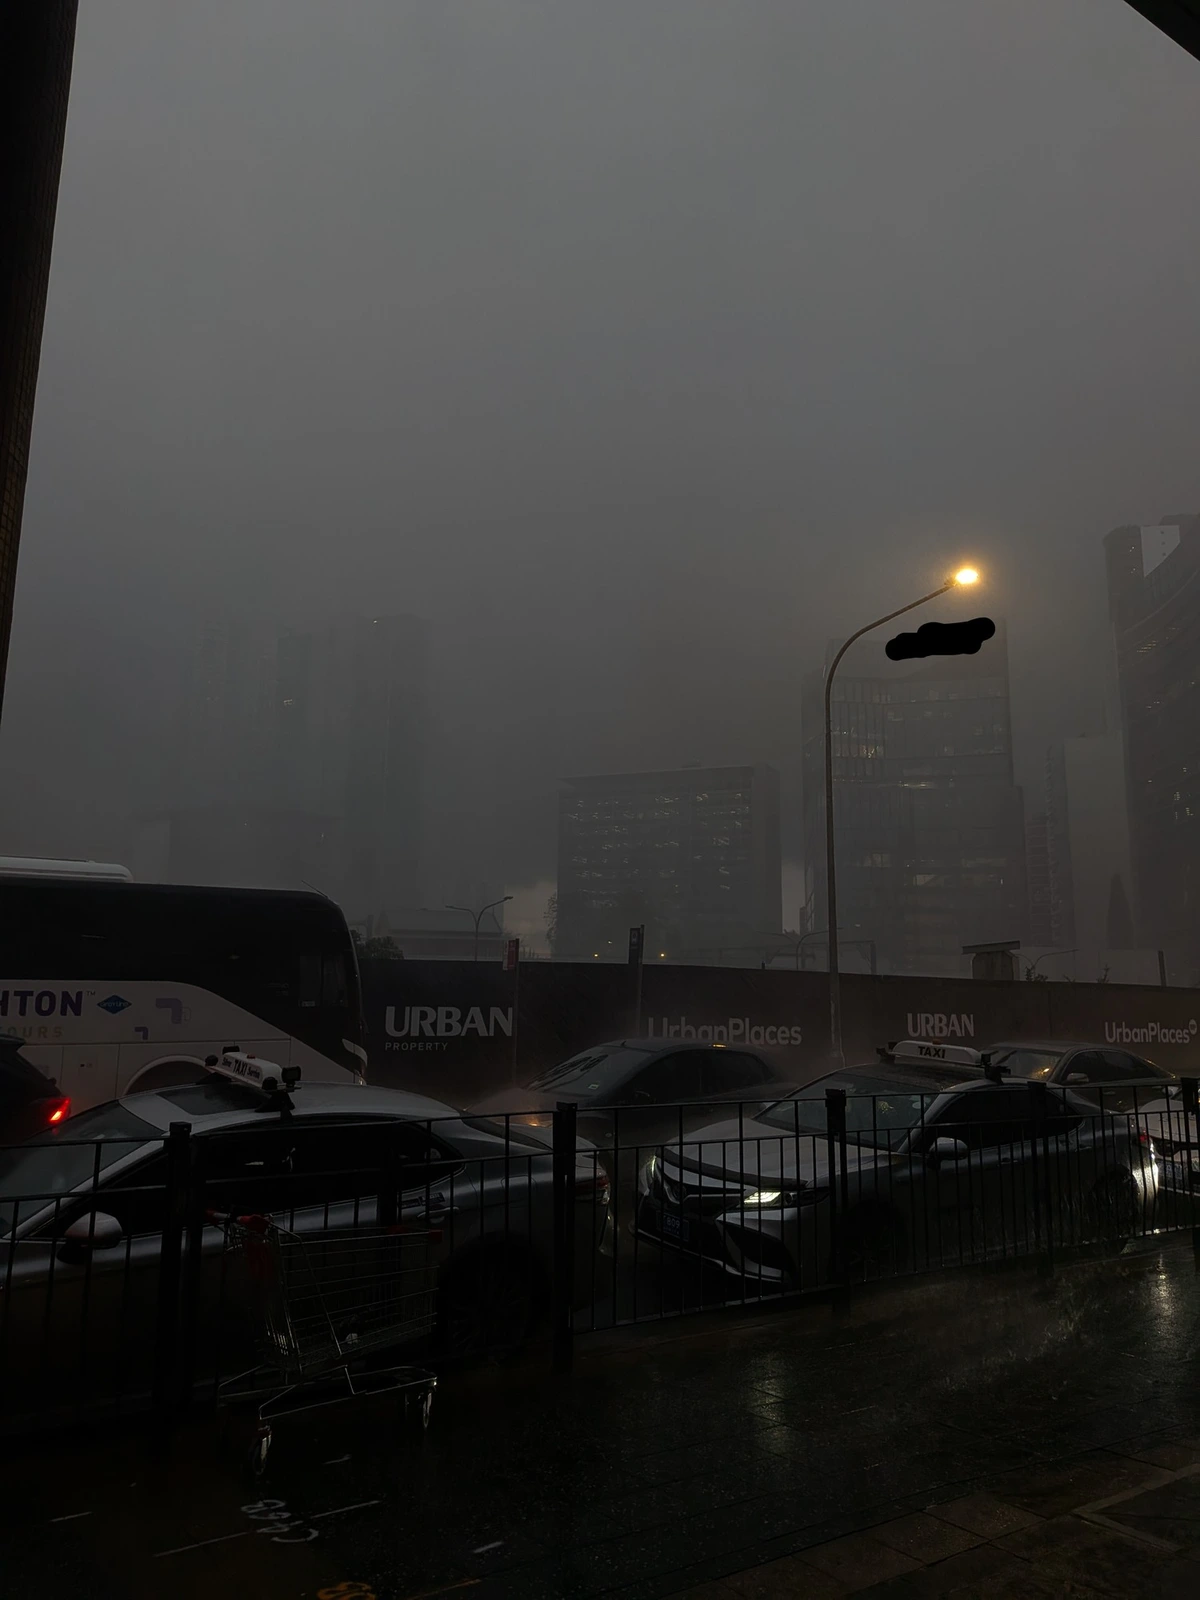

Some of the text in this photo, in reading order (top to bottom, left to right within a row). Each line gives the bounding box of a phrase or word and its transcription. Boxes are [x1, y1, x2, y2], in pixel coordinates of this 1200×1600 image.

[385, 1006, 513, 1037] URBAN
[907, 1012, 975, 1038] URBAN
[1104, 1021, 1191, 1044] UrbanPlaces
[385, 1042, 449, 1052] PROPERTY
[918, 1046, 946, 1059] TAXI
[233, 1059, 248, 1077] TAXI
